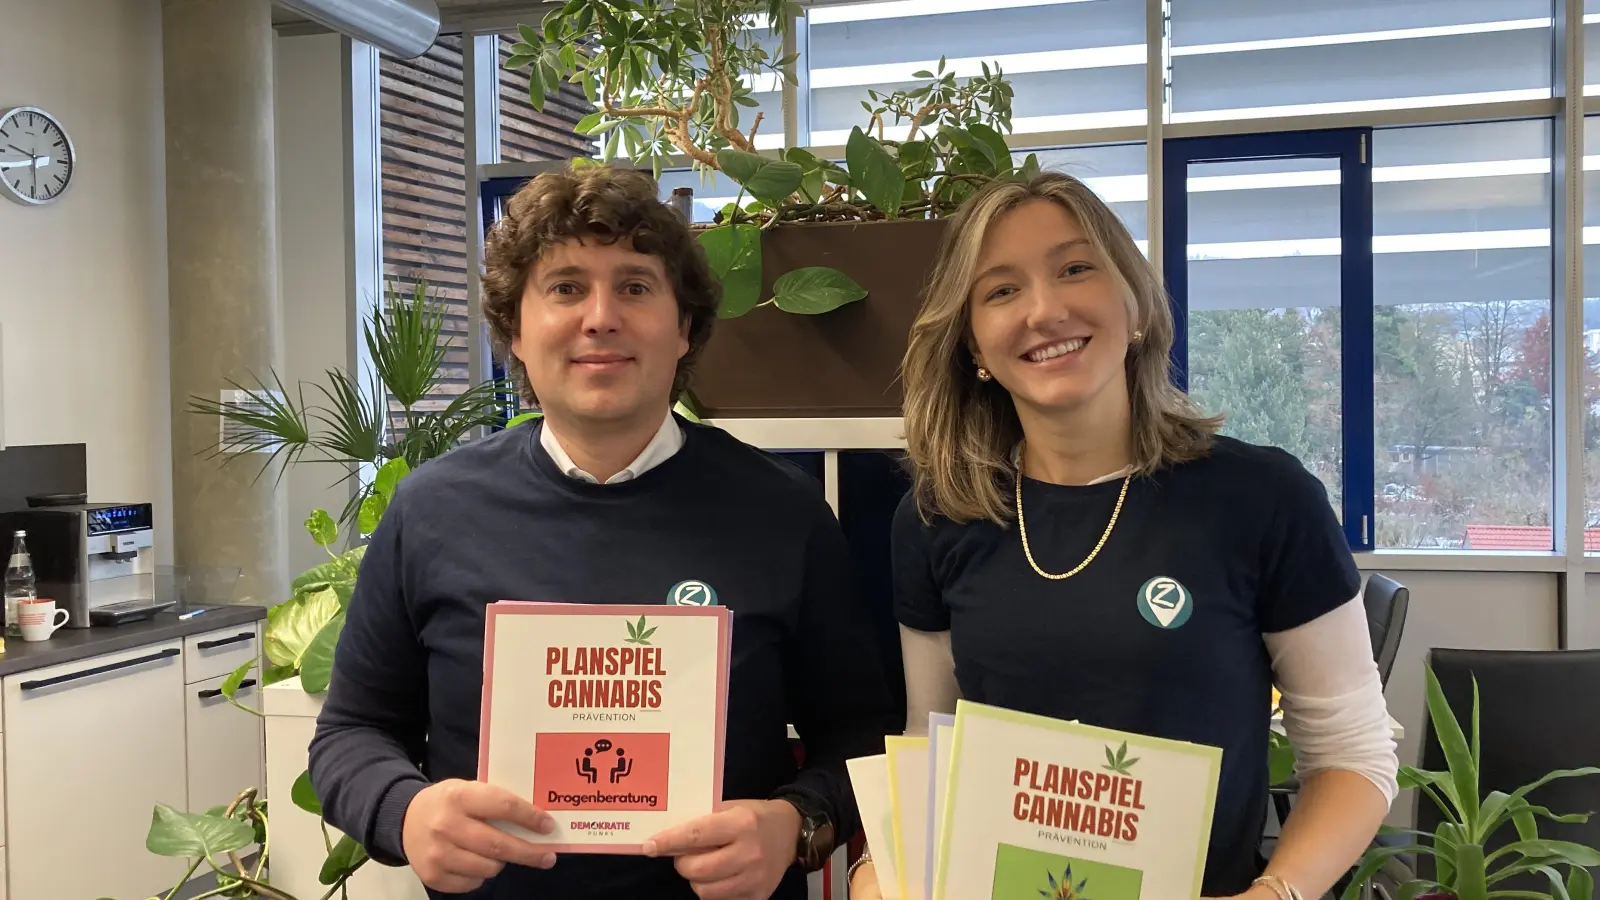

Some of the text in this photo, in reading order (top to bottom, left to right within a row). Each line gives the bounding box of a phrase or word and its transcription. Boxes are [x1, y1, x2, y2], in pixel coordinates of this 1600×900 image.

[546, 647, 666, 676] PLANSPIEL
[548, 679, 662, 709] CANNABIS
[572, 711, 636, 721] PRÄVENTION
[1013, 757, 1145, 810] PLANSPIEL
[548, 790, 658, 807] Drogenberatung
[570, 821, 631, 830] DEMOKRATIE
[1013, 791, 1139, 842] CANNABIS
[1037, 829, 1107, 851] PRÄVENTION
